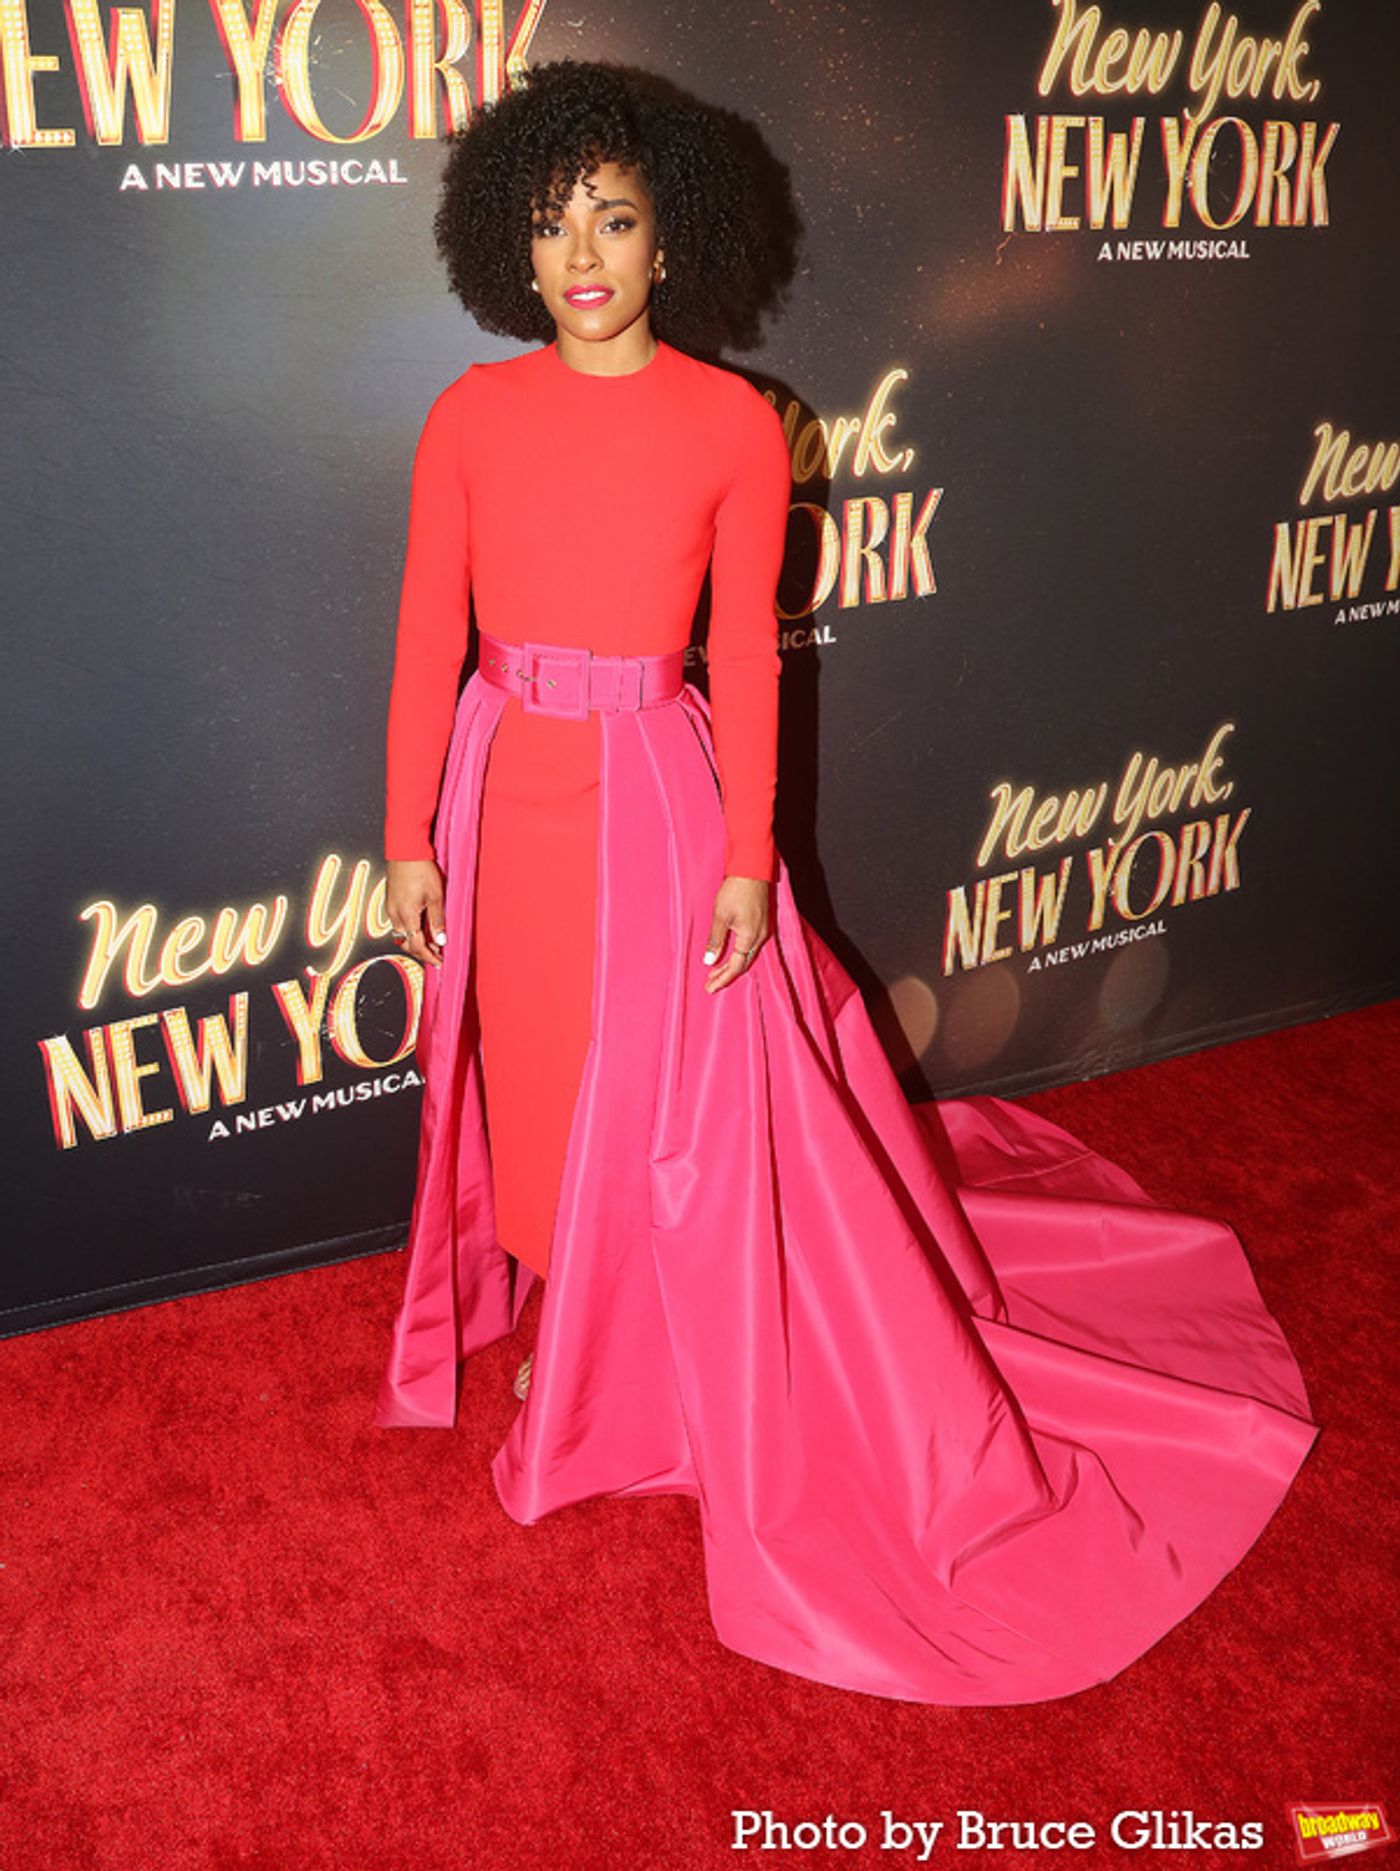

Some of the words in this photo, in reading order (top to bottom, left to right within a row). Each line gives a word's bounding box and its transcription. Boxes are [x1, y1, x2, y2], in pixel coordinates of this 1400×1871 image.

[0, 0, 176, 147] EW
[209, 0, 547, 144] YORK
[1038, 0, 1182, 97] New
[1183, 0, 1321, 122] York,
[119, 164, 148, 191] A
[154, 162, 246, 190] NEW
[251, 159, 408, 188] MUSICAL
[1002, 113, 1146, 232] NEW
[1160, 116, 1341, 230] YORK
[1097, 241, 1113, 262] A
[1116, 240, 1166, 261] NEW
[1166, 239, 1250, 261] MUSICAL
[1300, 422, 1400, 506] New
[774, 487, 944, 620] ORK
[1266, 508, 1378, 614] NEW
[777, 625, 837, 650] ICAL
[1334, 608, 1346, 625] A
[1349, 601, 1387, 622] NEW
[976, 782, 1107, 868] New
[1108, 723, 1234, 847] York,
[78, 895, 288, 1011] New
[304, 853, 393, 977] Yo
[941, 855, 1073, 977] NEW
[1086, 807, 1251, 932] YORK
[1027, 956, 1042, 974] A
[1045, 941, 1090, 967] NEW
[1091, 920, 1167, 953] MUSICAL
[37, 991, 249, 1150] NEW
[271, 954, 426, 1086] YO
[208, 1120, 230, 1142] A
[235, 1099, 307, 1134] NEW
[312, 1069, 426, 1114] MUSICA
